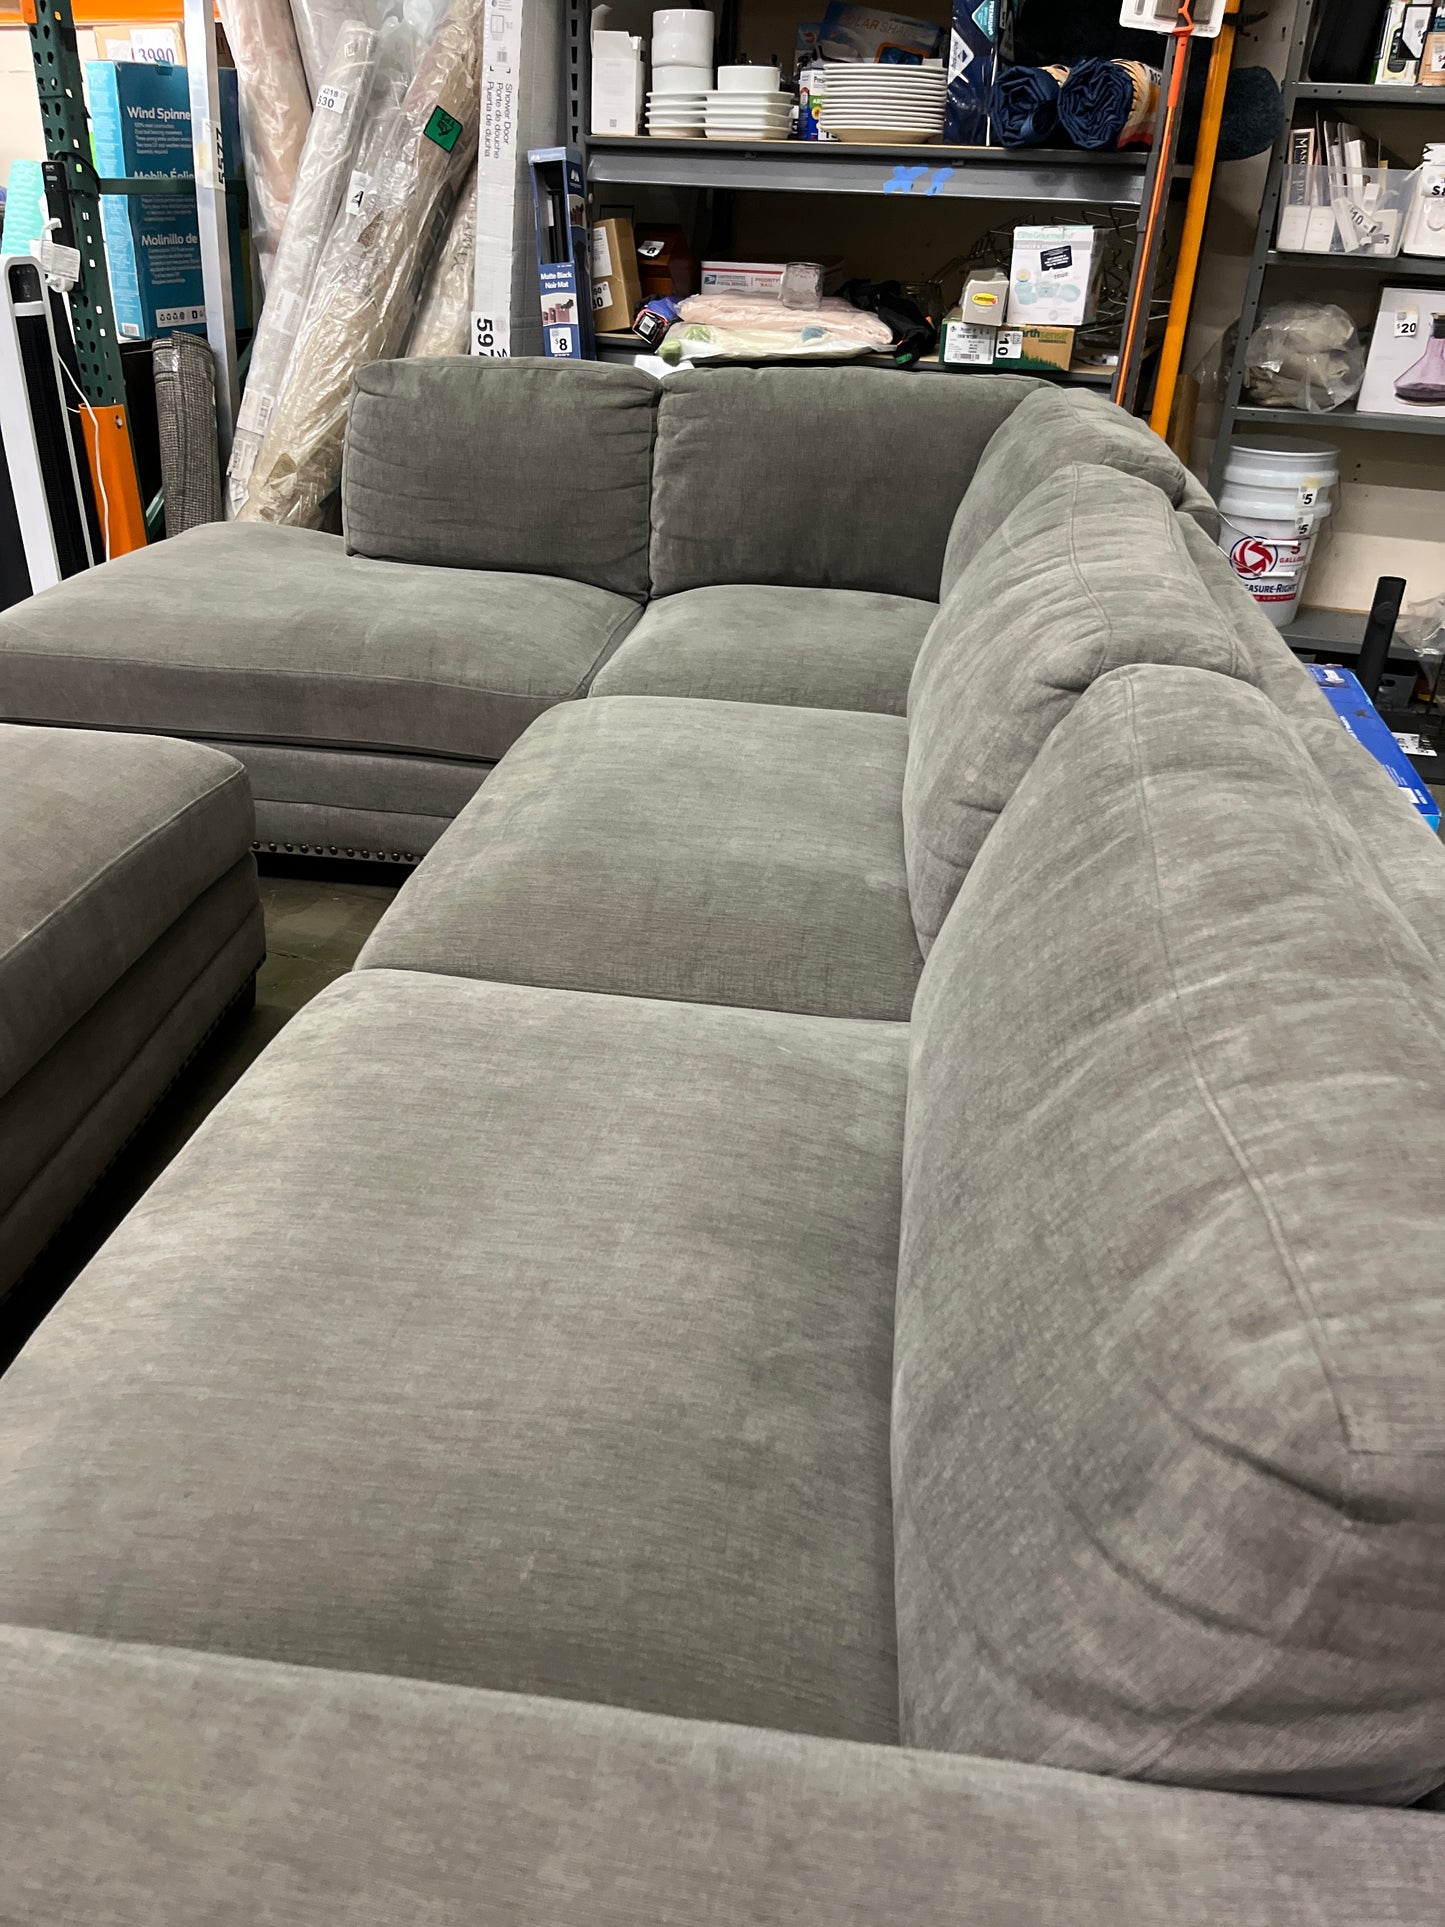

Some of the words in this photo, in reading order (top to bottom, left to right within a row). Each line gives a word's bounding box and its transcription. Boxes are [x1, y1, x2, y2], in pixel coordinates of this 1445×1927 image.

[486, 81, 495, 113] Puerta
[495, 82, 504, 108] Porte
[504, 83, 513, 120] Shower
[126, 106, 156, 119] Wind
[157, 107, 192, 122] Spinne
[485, 114, 493, 127] de
[494, 110, 502, 121] de
[493, 121, 502, 160] douche
[503, 121, 512, 145] Door
[484, 127, 492, 158] ducha
[1349, 207, 1364, 226] $10
[141, 233, 183, 246] Molinillo
[185, 233, 198, 244] de
[556, 271, 573, 279] Black
[1396, 322, 1417, 334] $20
[476, 317, 494, 357] 597
[555, 338, 568, 351] $8
[997, 332, 1011, 356] $10
[1302, 493, 1314, 505] $5
[1298, 523, 1309, 535] $5
